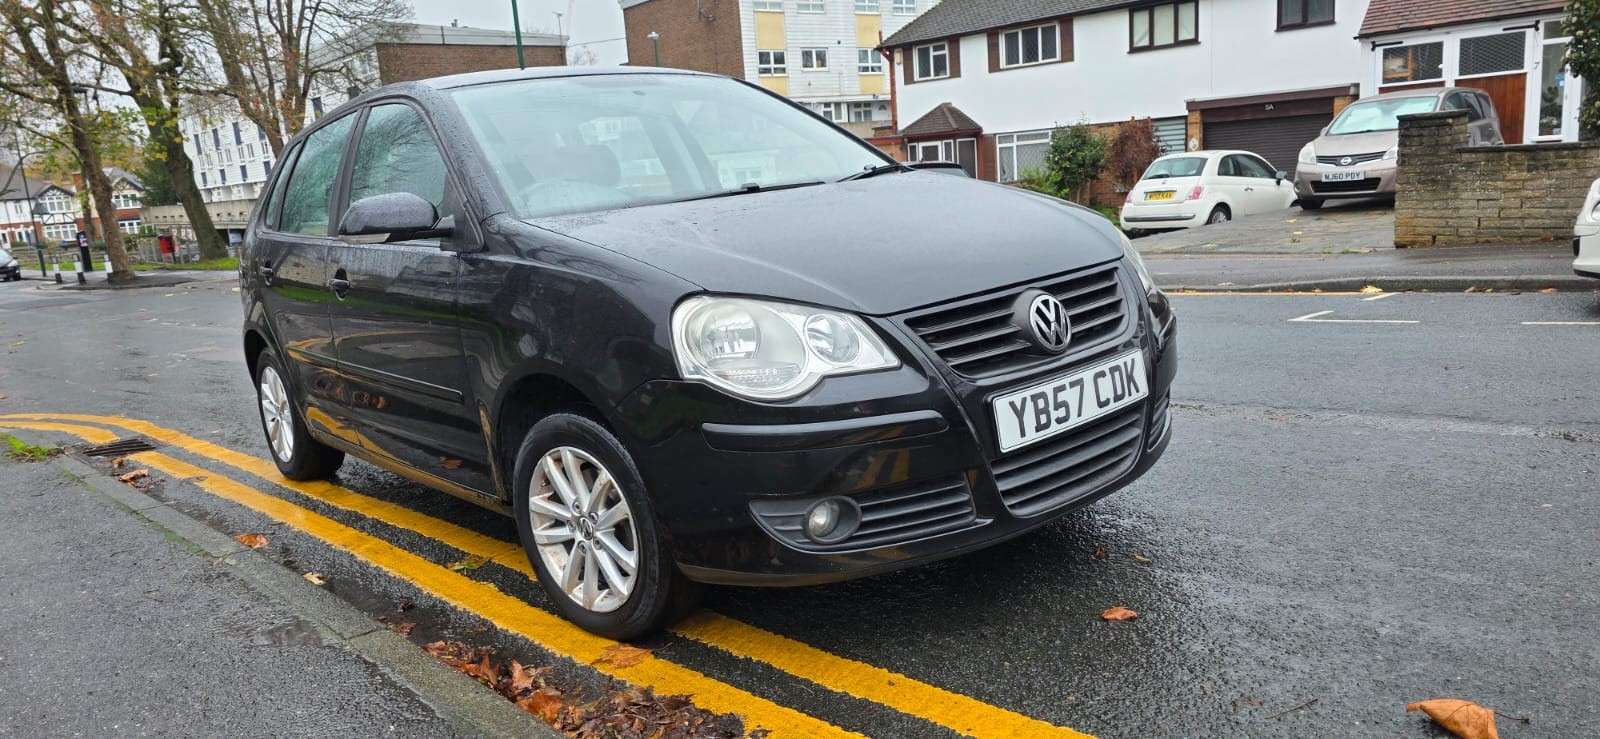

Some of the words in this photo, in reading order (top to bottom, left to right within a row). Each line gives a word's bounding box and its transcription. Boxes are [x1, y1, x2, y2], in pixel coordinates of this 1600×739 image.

[1031, 295, 1071, 350] VW
[1009, 378, 1084, 438] YB57
[1093, 358, 1140, 409] CDK
